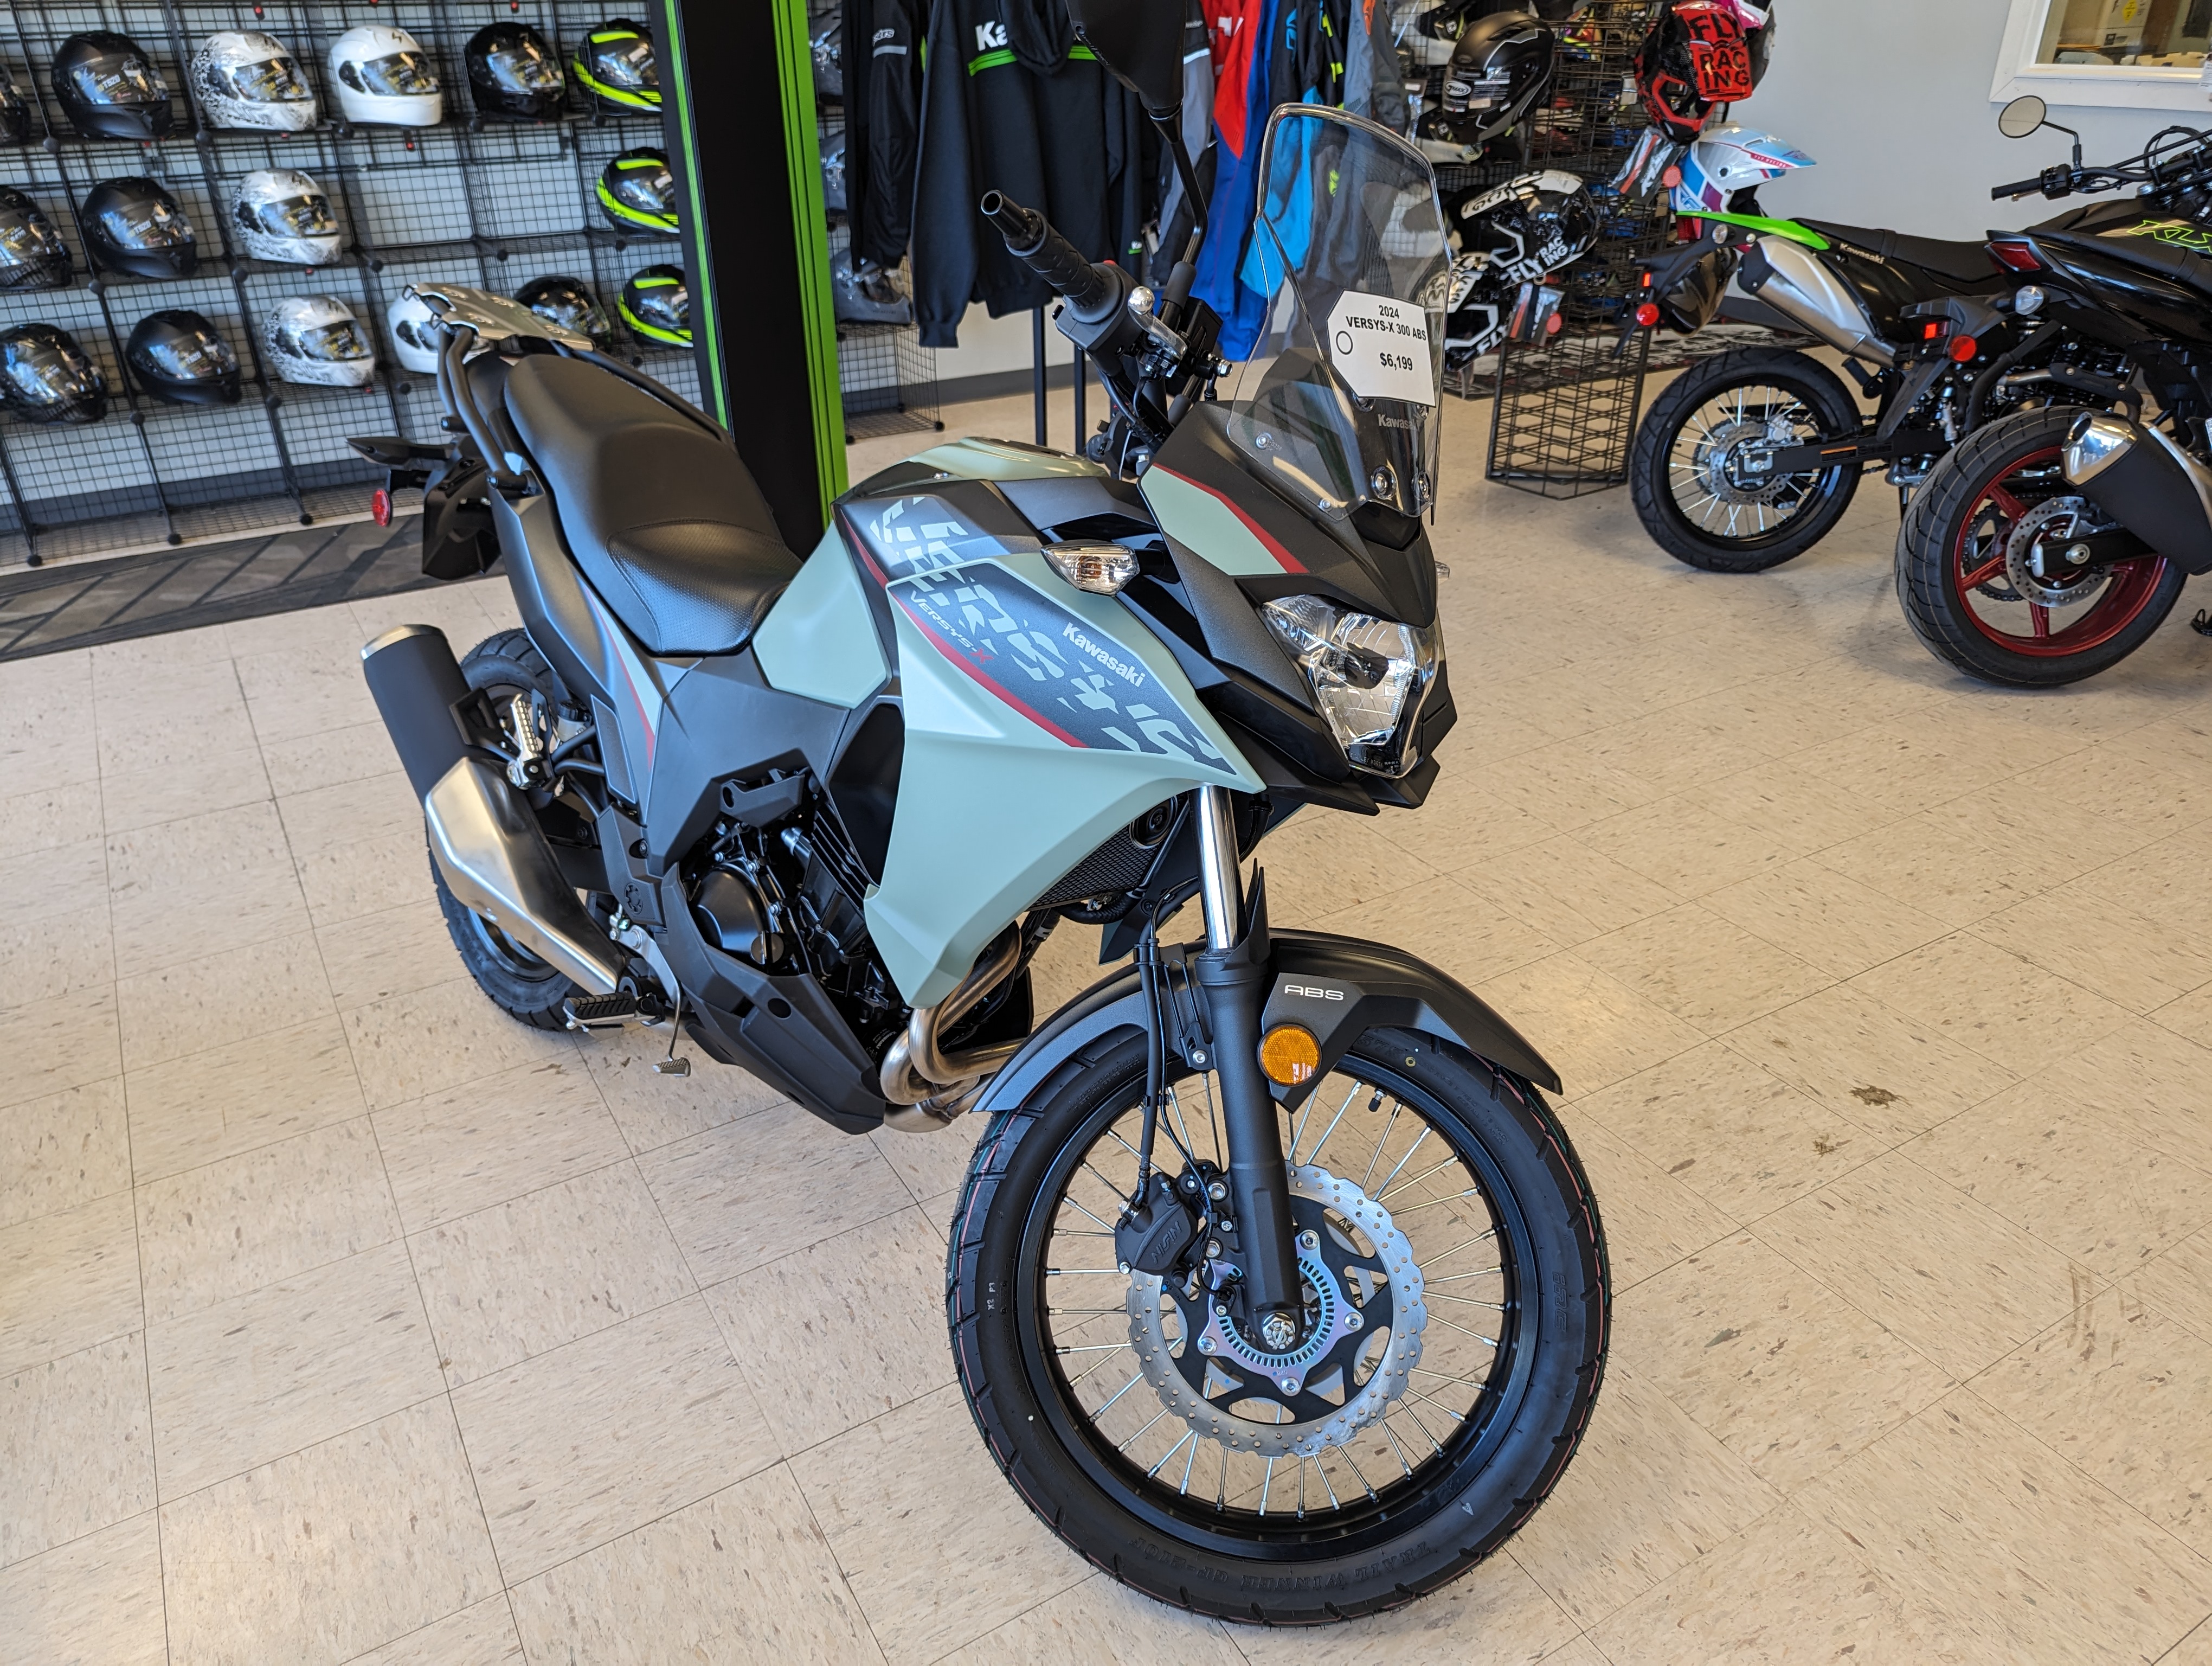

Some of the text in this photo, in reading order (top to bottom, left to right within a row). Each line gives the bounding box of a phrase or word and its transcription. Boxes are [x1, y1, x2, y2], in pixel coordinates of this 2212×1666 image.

[1700, 50, 1746, 71] RAC
[1703, 70, 1749, 88] ING
[1539, 236, 1564, 258] RAC
[1544, 245, 1568, 266] ING
[1840, 243, 1885, 264] Kawasaki
[1506, 252, 1544, 283] FLY
[1379, 305, 1399, 319] 2024
[1346, 316, 1426, 341] VERSYS-X 300 ABS
[1380, 352, 1413, 371] $6,199
[911, 590, 994, 664] VERSYS-X
[1063, 622, 1146, 688] Kawasaki
[1284, 984, 1345, 1001] ABS
[1355, 1541, 1430, 1580] TRAIL
[1241, 1572, 1345, 1590] WINNER
